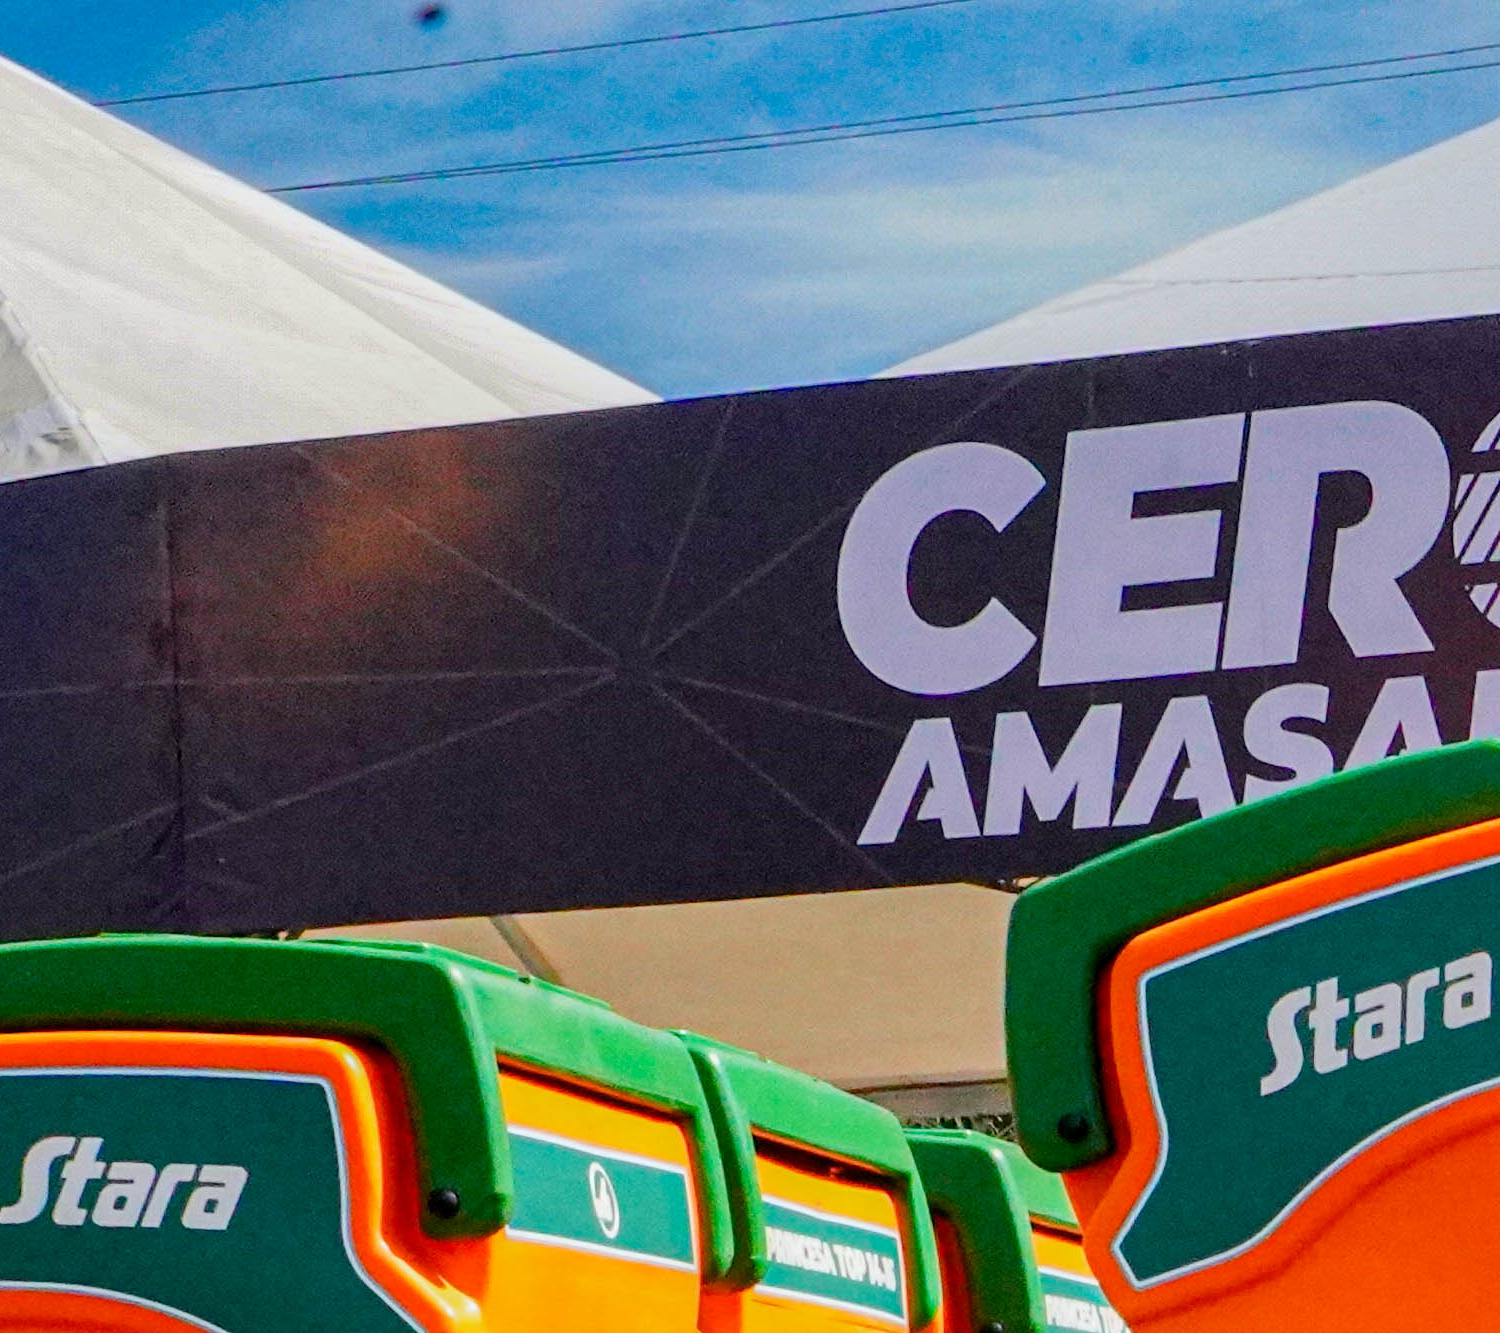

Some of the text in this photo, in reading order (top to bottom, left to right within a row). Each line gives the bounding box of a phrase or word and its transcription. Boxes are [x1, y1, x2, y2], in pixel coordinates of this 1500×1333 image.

[1260, 948, 1495, 1097] Stara
[764, 1226, 838, 1276] PRINCESA
[833, 1245, 867, 1283] TOP
